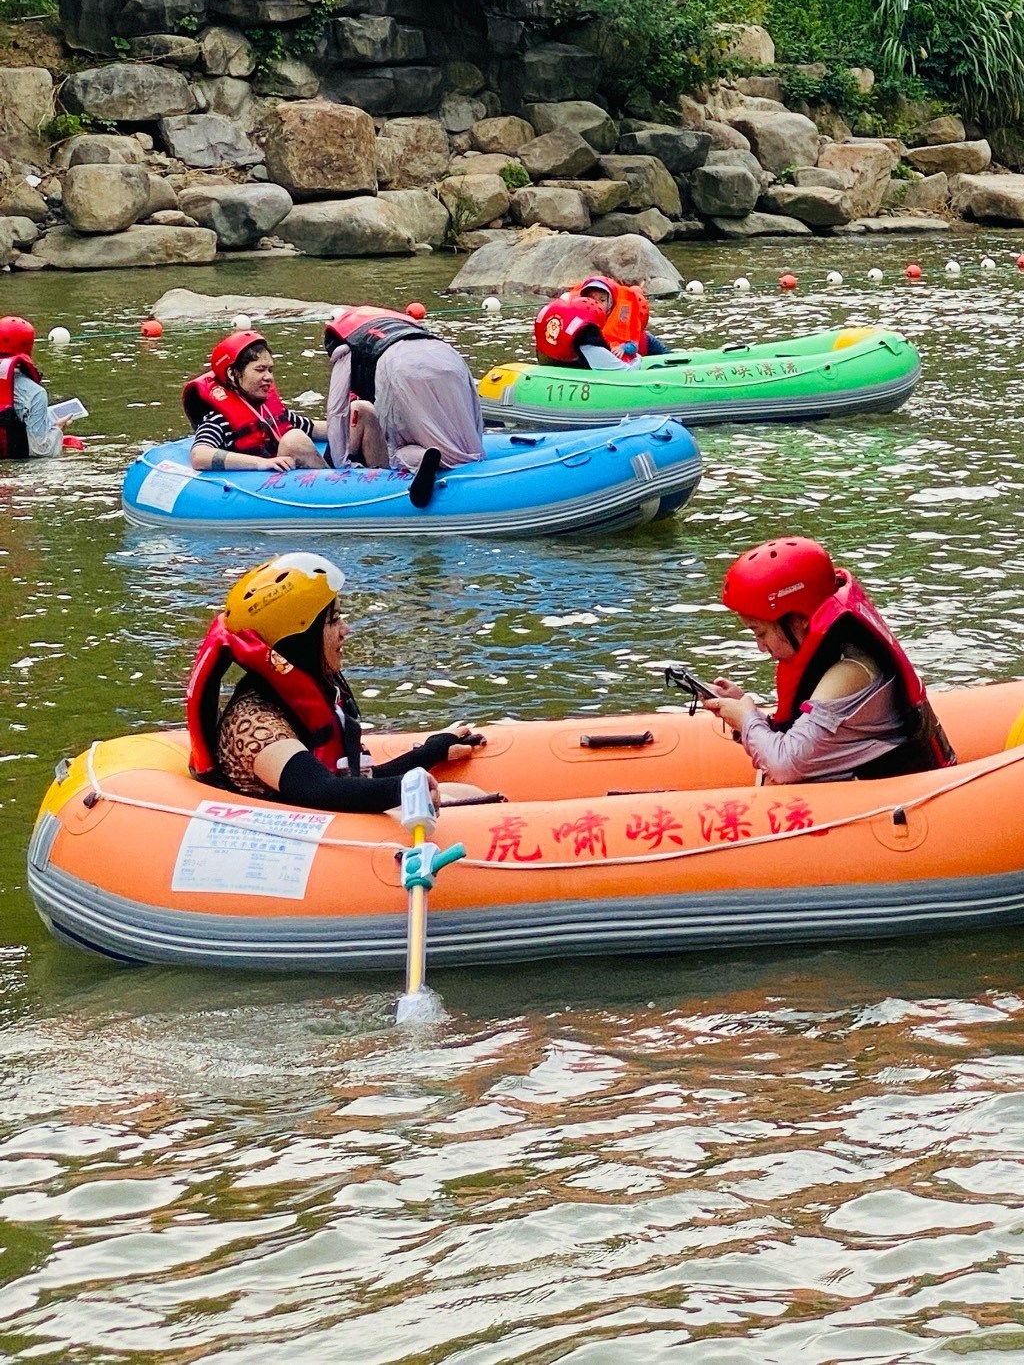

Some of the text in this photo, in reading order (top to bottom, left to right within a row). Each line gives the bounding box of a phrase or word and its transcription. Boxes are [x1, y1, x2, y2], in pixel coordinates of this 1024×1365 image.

[683, 361, 801, 385] 虎啸峡漂流
[546, 384, 591, 402] 1178
[486, 796, 829, 863] 虎啸峡漂流
